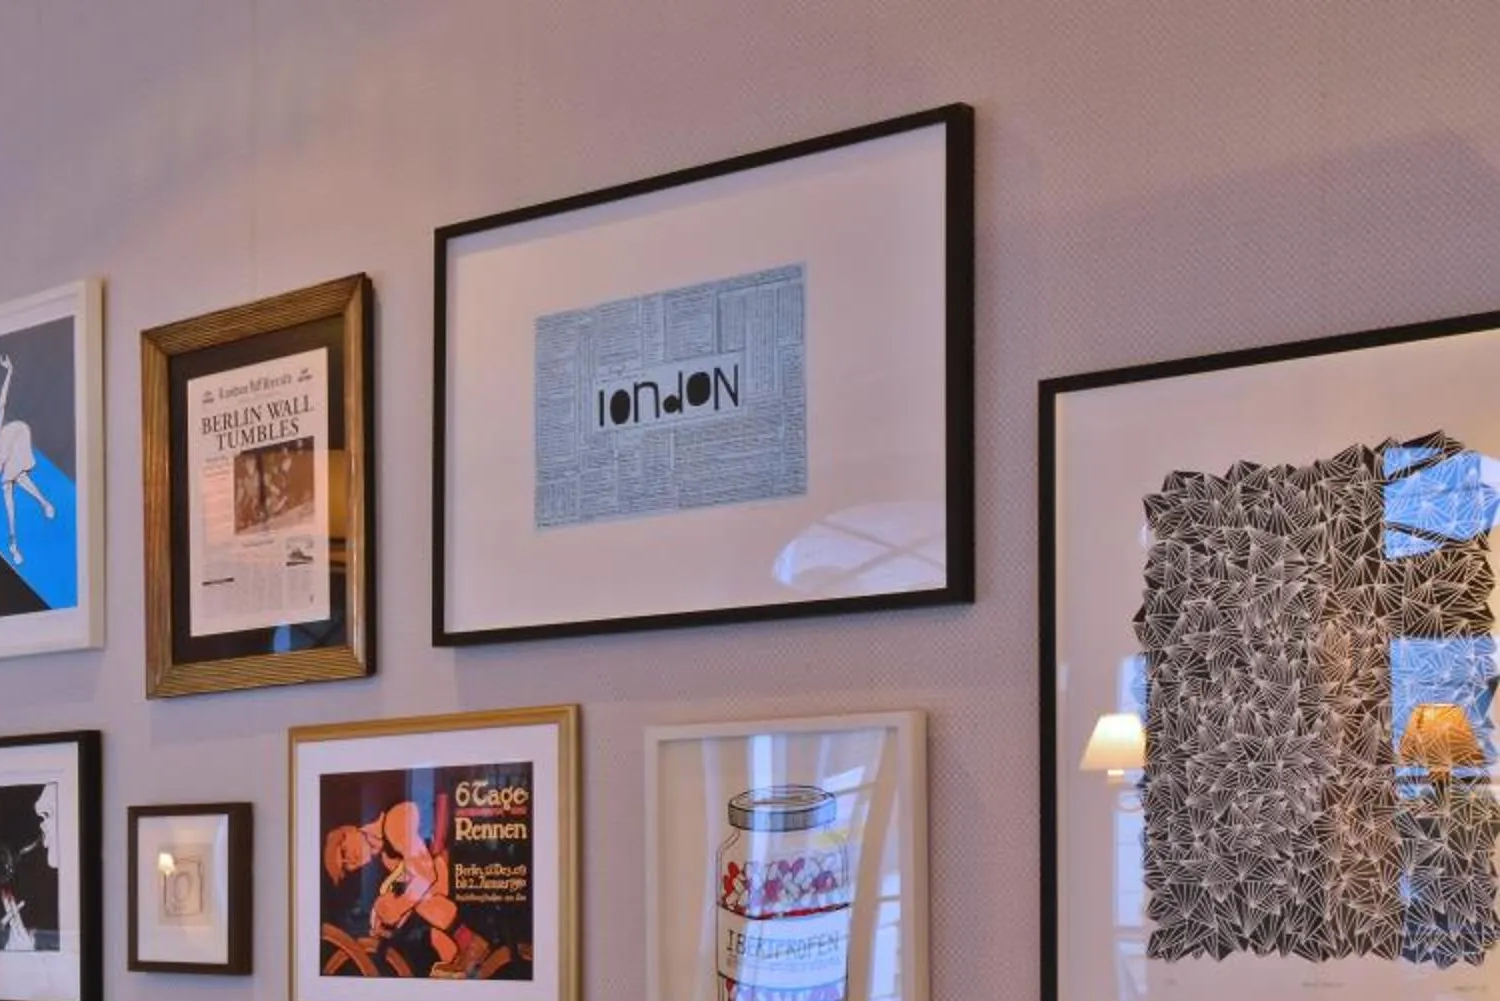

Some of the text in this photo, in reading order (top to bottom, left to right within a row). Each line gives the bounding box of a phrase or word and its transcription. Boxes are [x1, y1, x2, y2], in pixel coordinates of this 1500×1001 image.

[200, 394, 315, 435] BERLIN WALL
[215, 417, 300, 451] TUMBLES
[454, 817, 528, 841] Rennen
